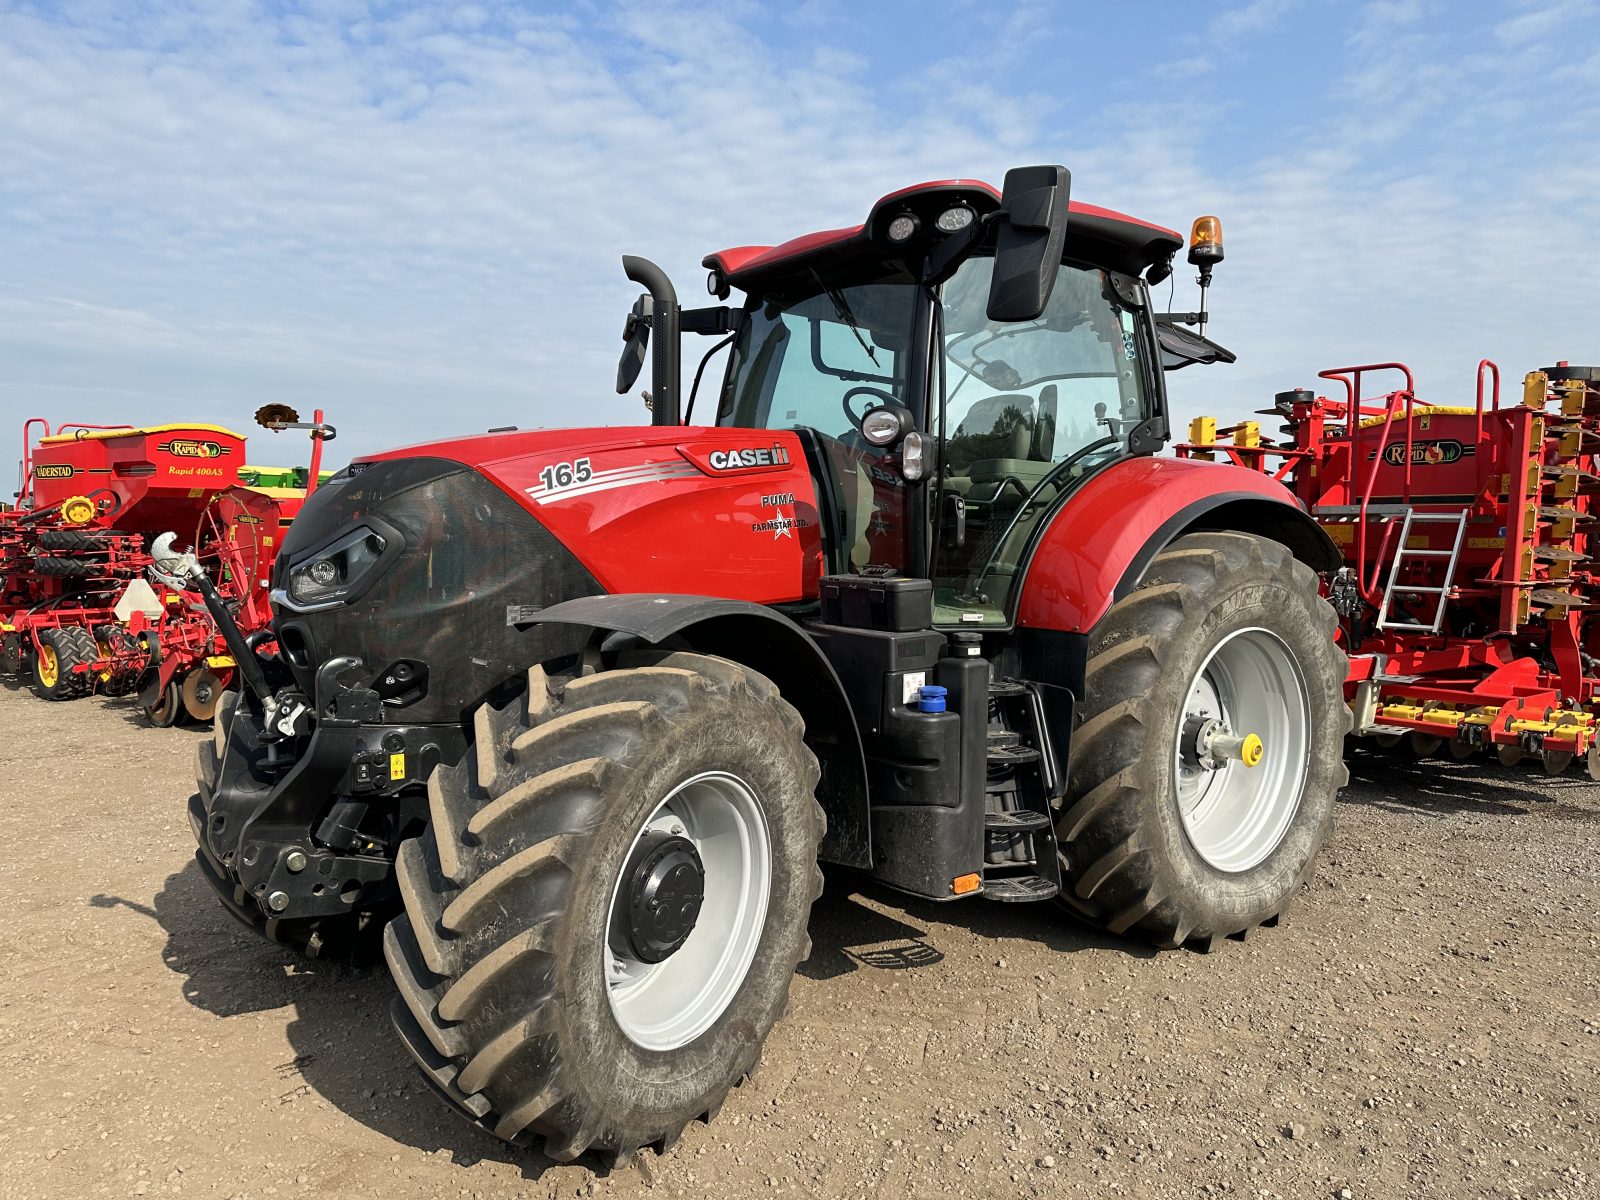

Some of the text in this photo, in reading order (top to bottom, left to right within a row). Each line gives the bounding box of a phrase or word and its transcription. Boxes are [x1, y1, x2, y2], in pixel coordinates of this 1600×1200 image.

[174, 443, 197, 455] RAPID
[710, 449, 770, 470] CASE
[169, 466, 223, 476] Rapid 400AS
[540, 458, 592, 491] 165
[761, 492, 796, 507] PUMA
[752, 520, 792, 531] FARMSTAR
